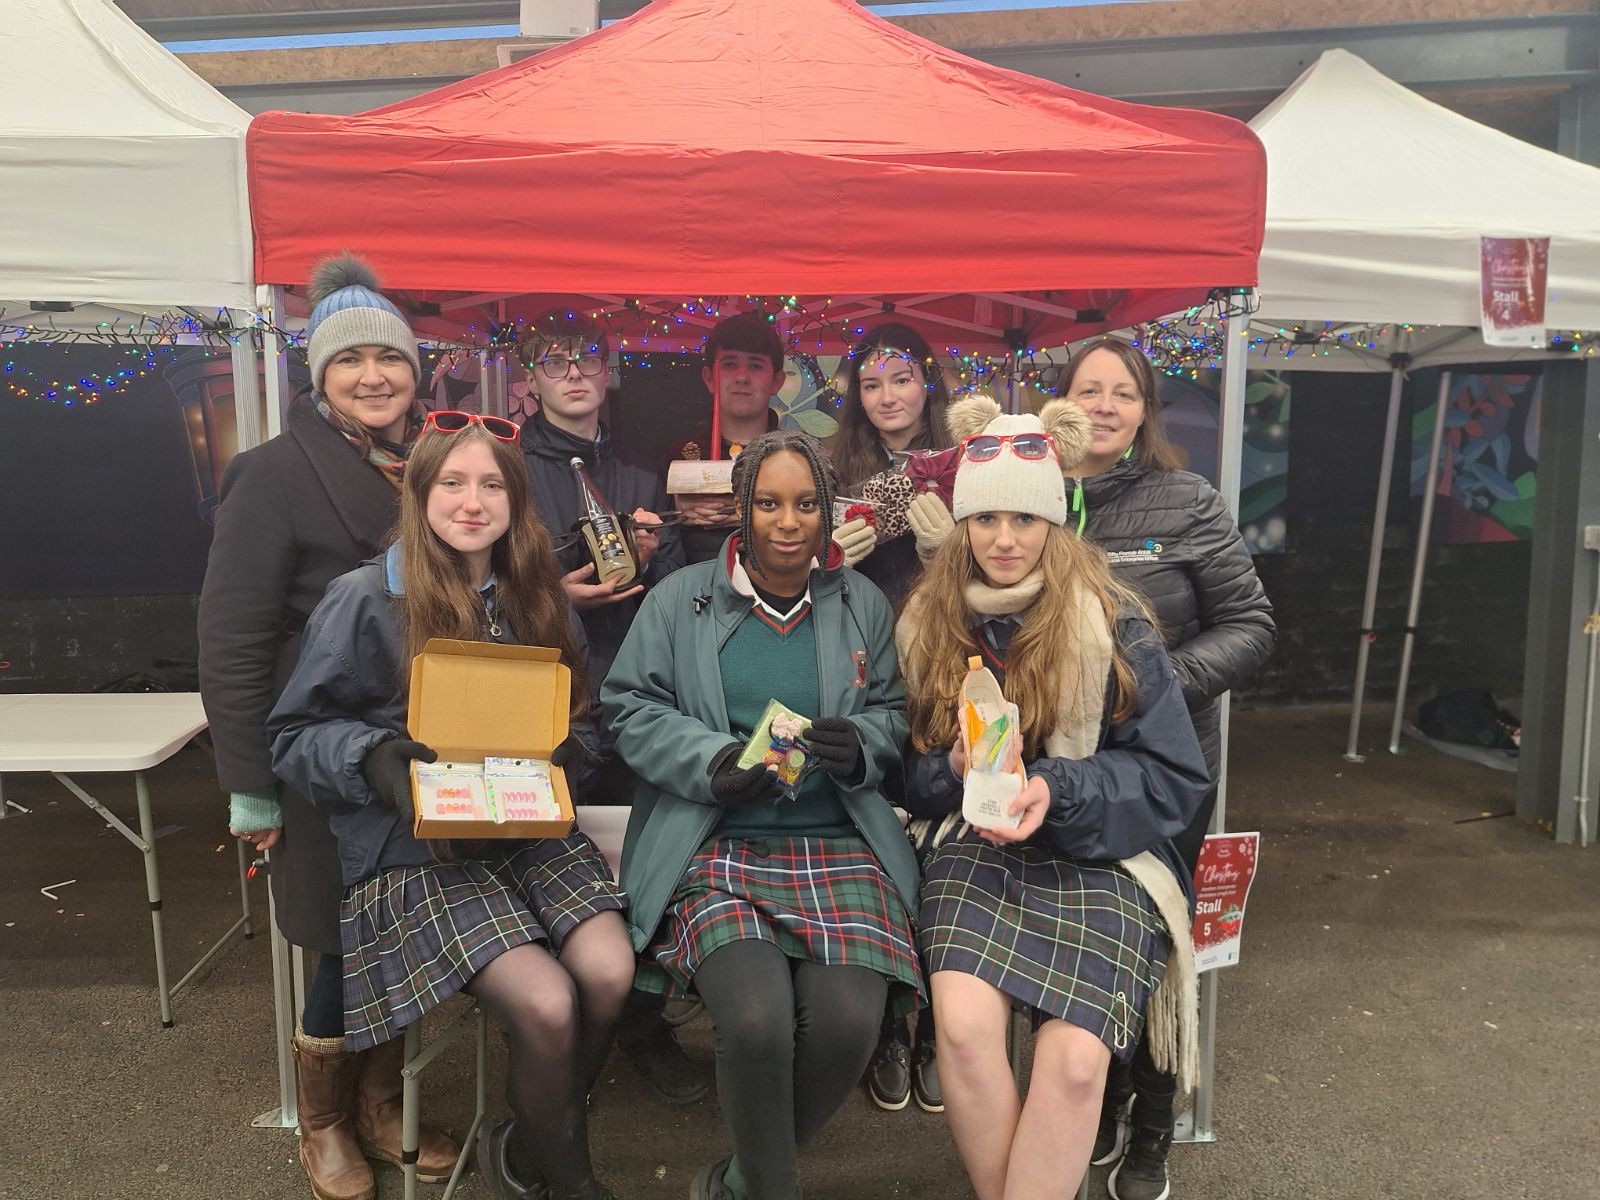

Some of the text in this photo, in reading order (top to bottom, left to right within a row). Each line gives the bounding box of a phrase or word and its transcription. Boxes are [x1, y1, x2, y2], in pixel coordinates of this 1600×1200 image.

[1493, 290, 1519, 302] Stall
[1502, 309, 1510, 320] 4
[1196, 899, 1222, 915] Stall
[1203, 922, 1211, 936] 5
